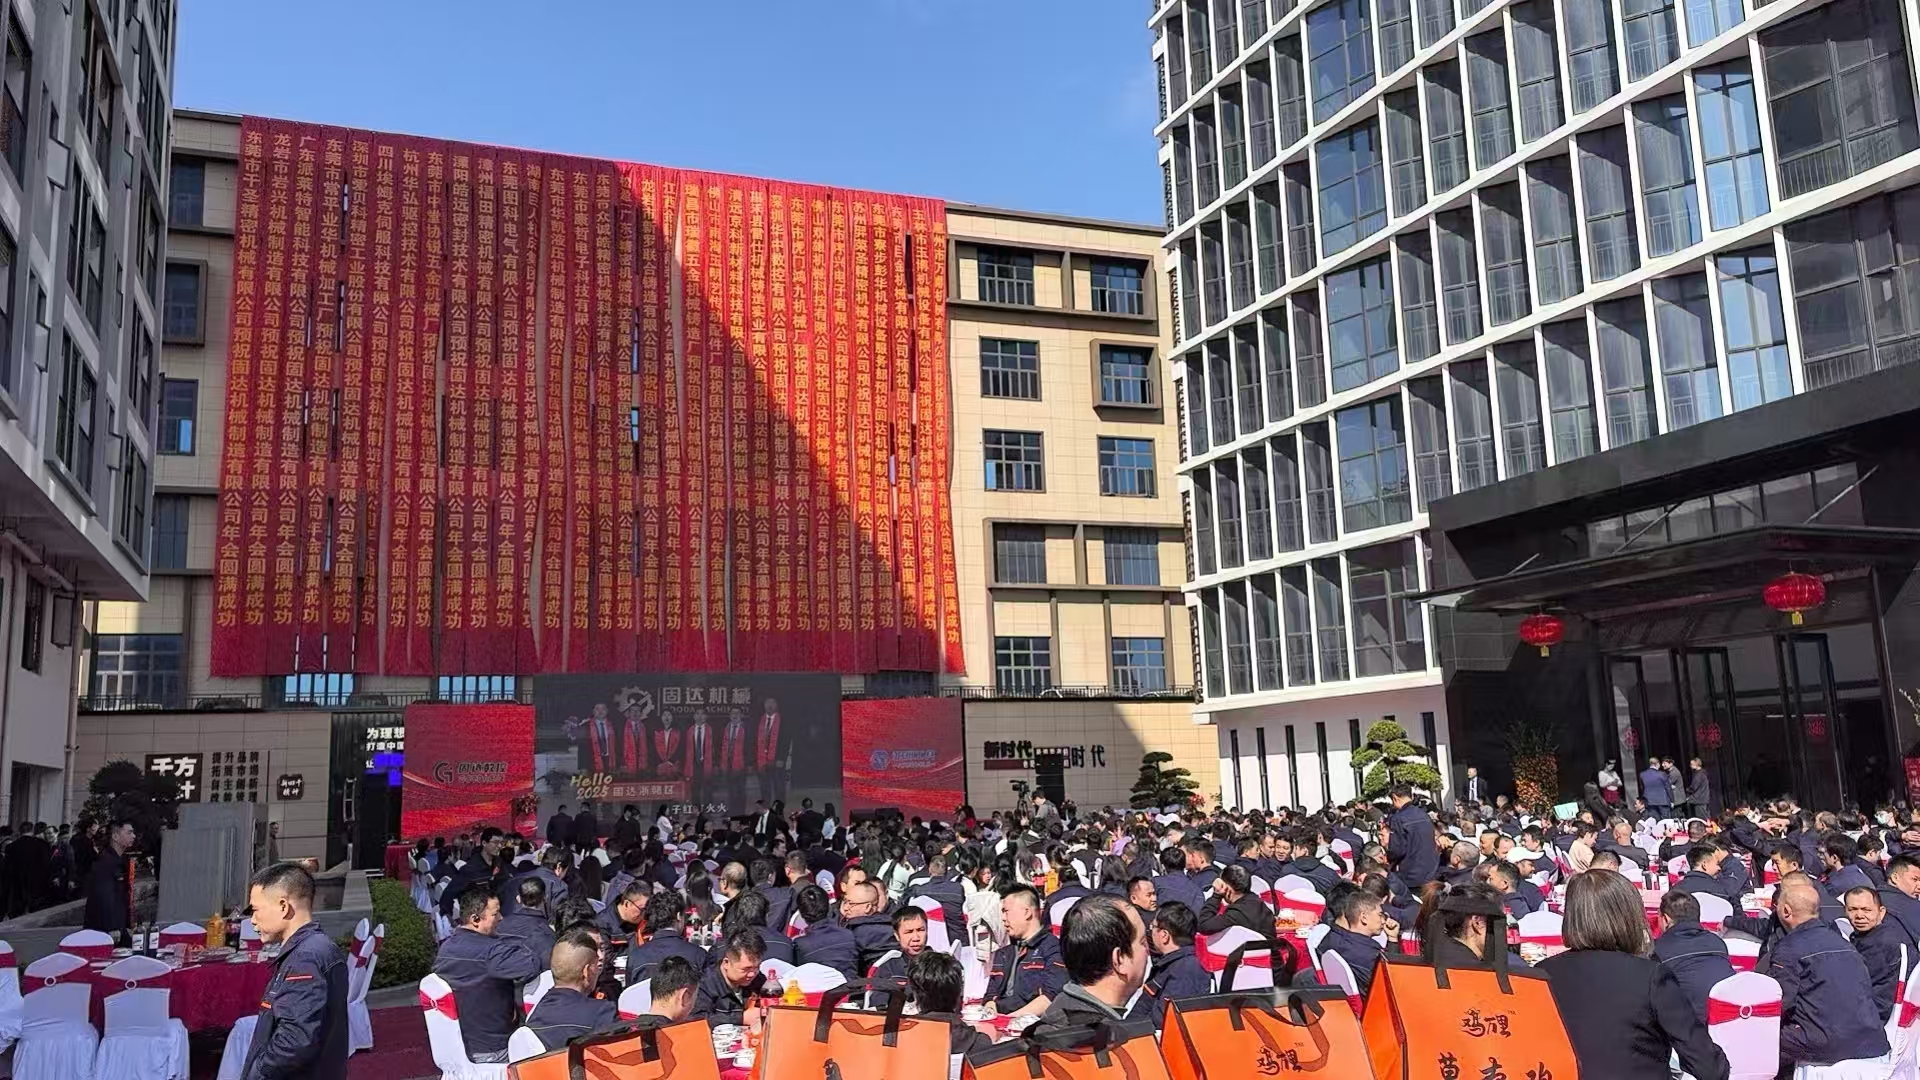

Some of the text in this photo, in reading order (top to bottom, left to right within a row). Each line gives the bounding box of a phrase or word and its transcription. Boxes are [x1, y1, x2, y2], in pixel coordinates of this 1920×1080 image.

[662, 686, 751, 705] 固达机械
[983, 740, 1033, 759] 新时代
[570, 772, 613, 787] Hello
[576, 785, 610, 800] 2025
